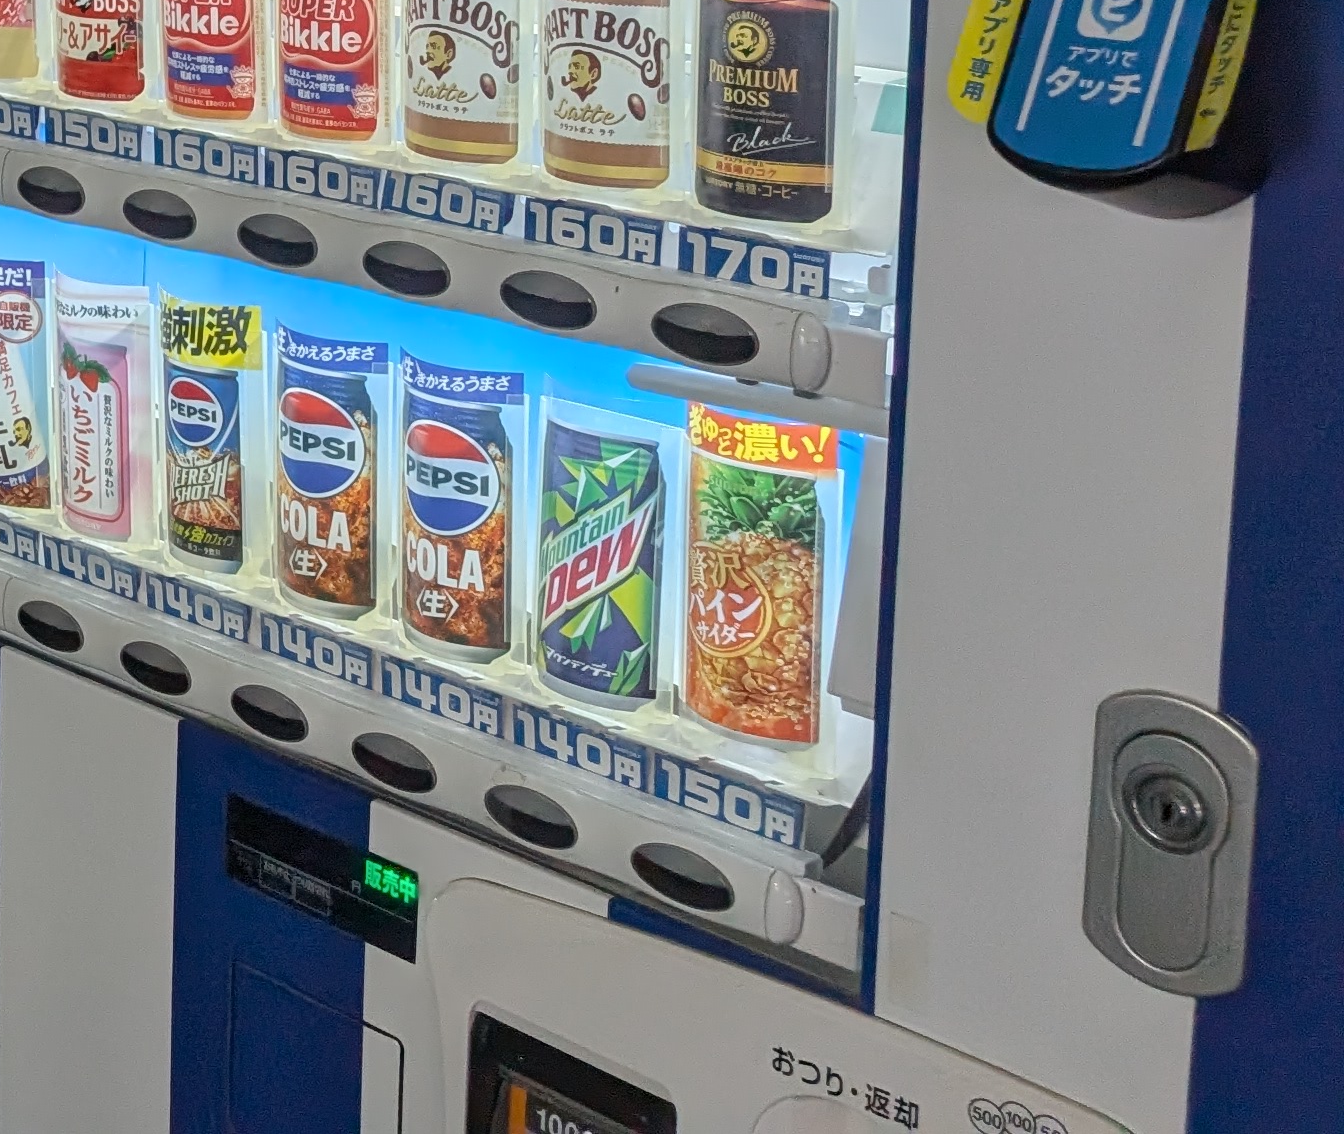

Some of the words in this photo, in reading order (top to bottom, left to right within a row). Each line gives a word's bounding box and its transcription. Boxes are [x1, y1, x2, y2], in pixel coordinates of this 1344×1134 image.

[164, 7, 239, 37] Bikkle
[282, 18, 363, 53] Bikkle
[709, 58, 799, 94] PREMIUM
[1066, 44, 1139, 64] アプリで
[412, 77, 478, 104] Latte
[723, 85, 770, 108] BOSS
[1045, 66, 1145, 106] タッチ
[47, 112, 140, 160] 150円
[552, 97, 627, 127] Latte
[159, 132, 255, 184] 160円
[270, 152, 371, 203] 160円
[387, 176, 501, 234] 160円
[528, 201, 659, 267] 160円
[684, 232, 827, 299] 170円
[169, 399, 218, 424] PEPSI
[69, 383, 99, 504] いちごミルク
[280, 424, 357, 463] PEPSI
[407, 453, 491, 498] PEPSI
[280, 495, 352, 552] COLA
[43, 537, 137, 601] 140円
[407, 531, 485, 593] COLA
[146, 575, 246, 641] 140円
[689, 589, 764, 625] パイン
[259, 617, 371, 688] 140円
[695, 620, 756, 647] サイダー
[384, 659, 501, 735] 140円
[518, 710, 644, 790] 140円
[660, 760, 799, 847] 150円
[364, 858, 418, 904] 販売中
[770, 1045, 922, 1131] おつり・返却
[972, 1104, 1002, 1128] 500
[1006, 1107, 1034, 1130] 100
